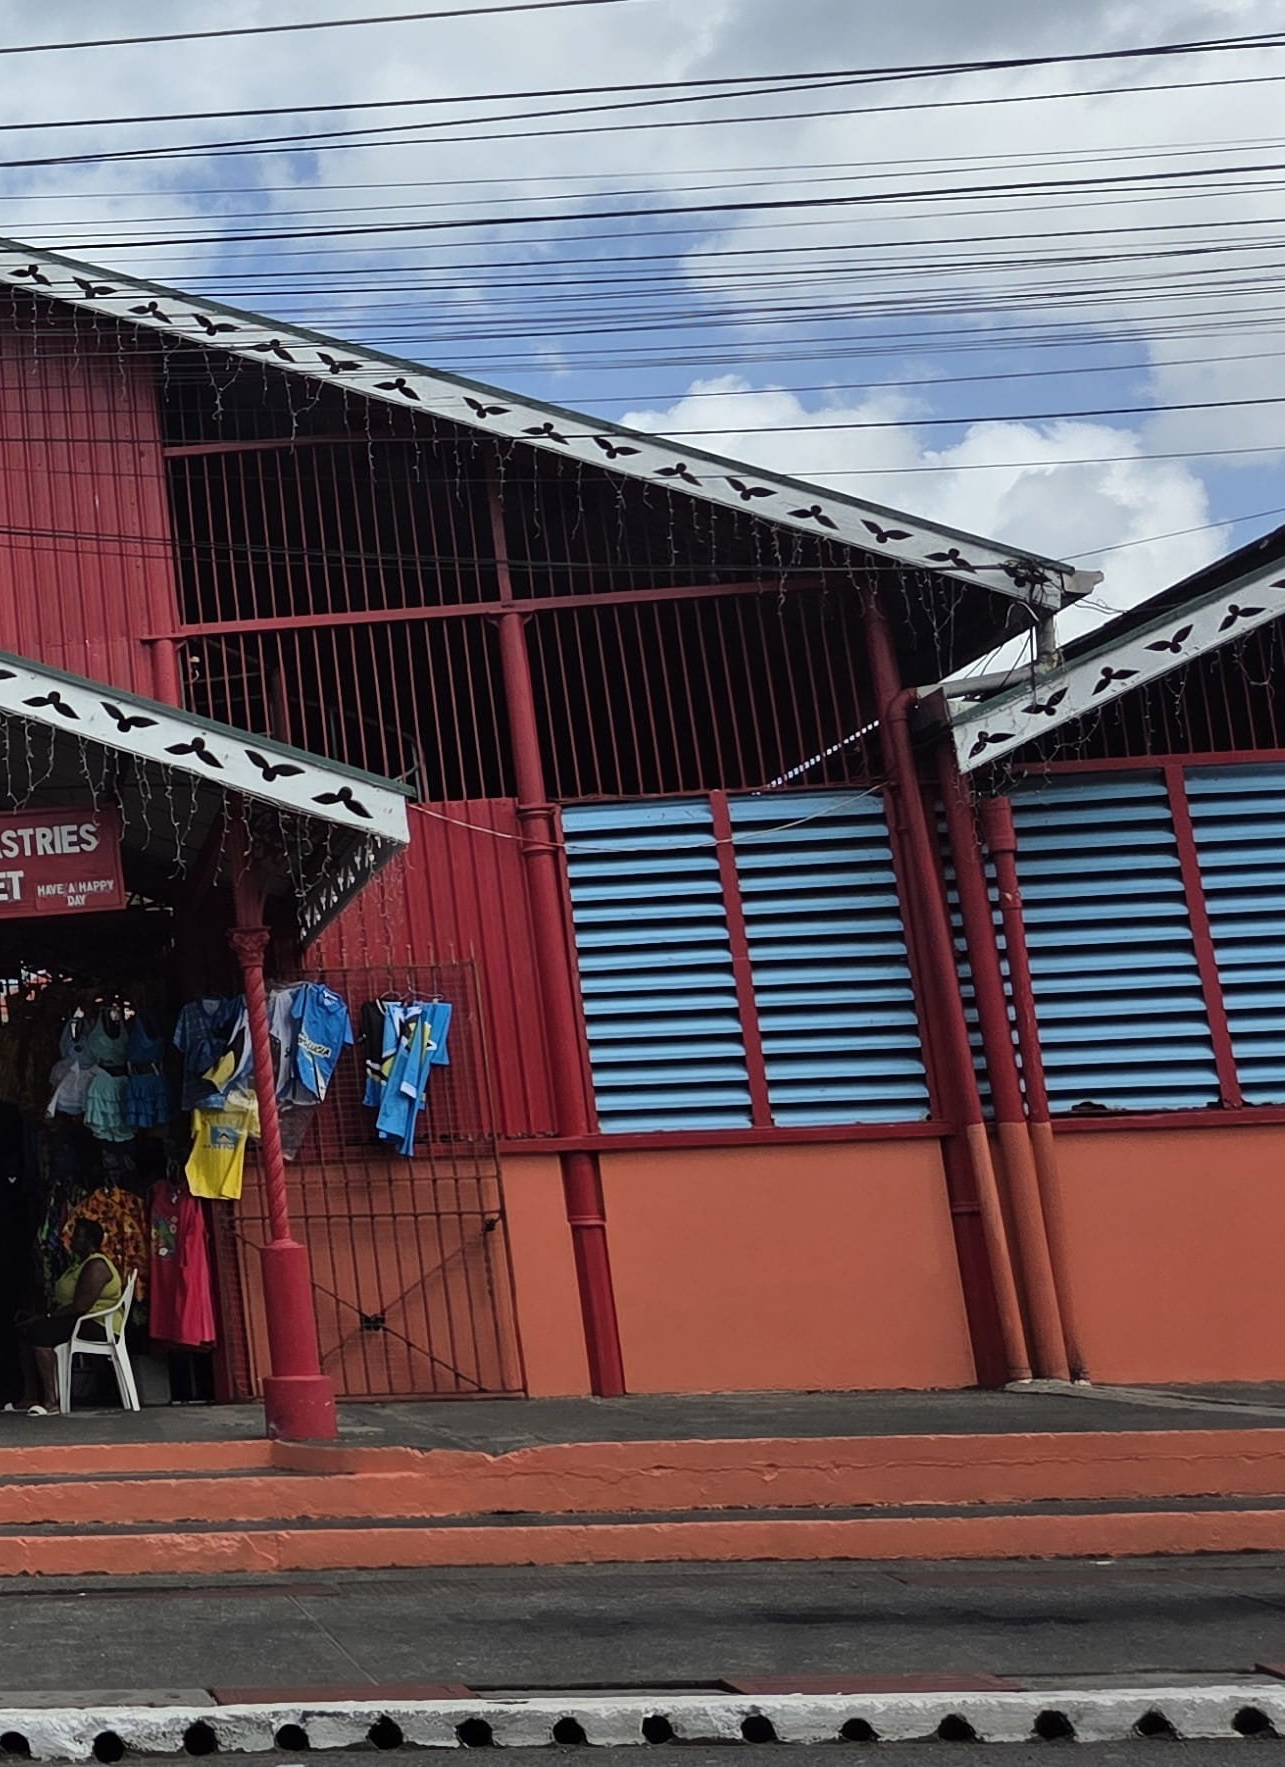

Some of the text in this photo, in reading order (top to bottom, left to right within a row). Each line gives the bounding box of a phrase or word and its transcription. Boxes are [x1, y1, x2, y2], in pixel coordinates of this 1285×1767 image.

[37, 879, 114, 896] HAVE A HAPPY
[67, 895, 86, 907] DAY
